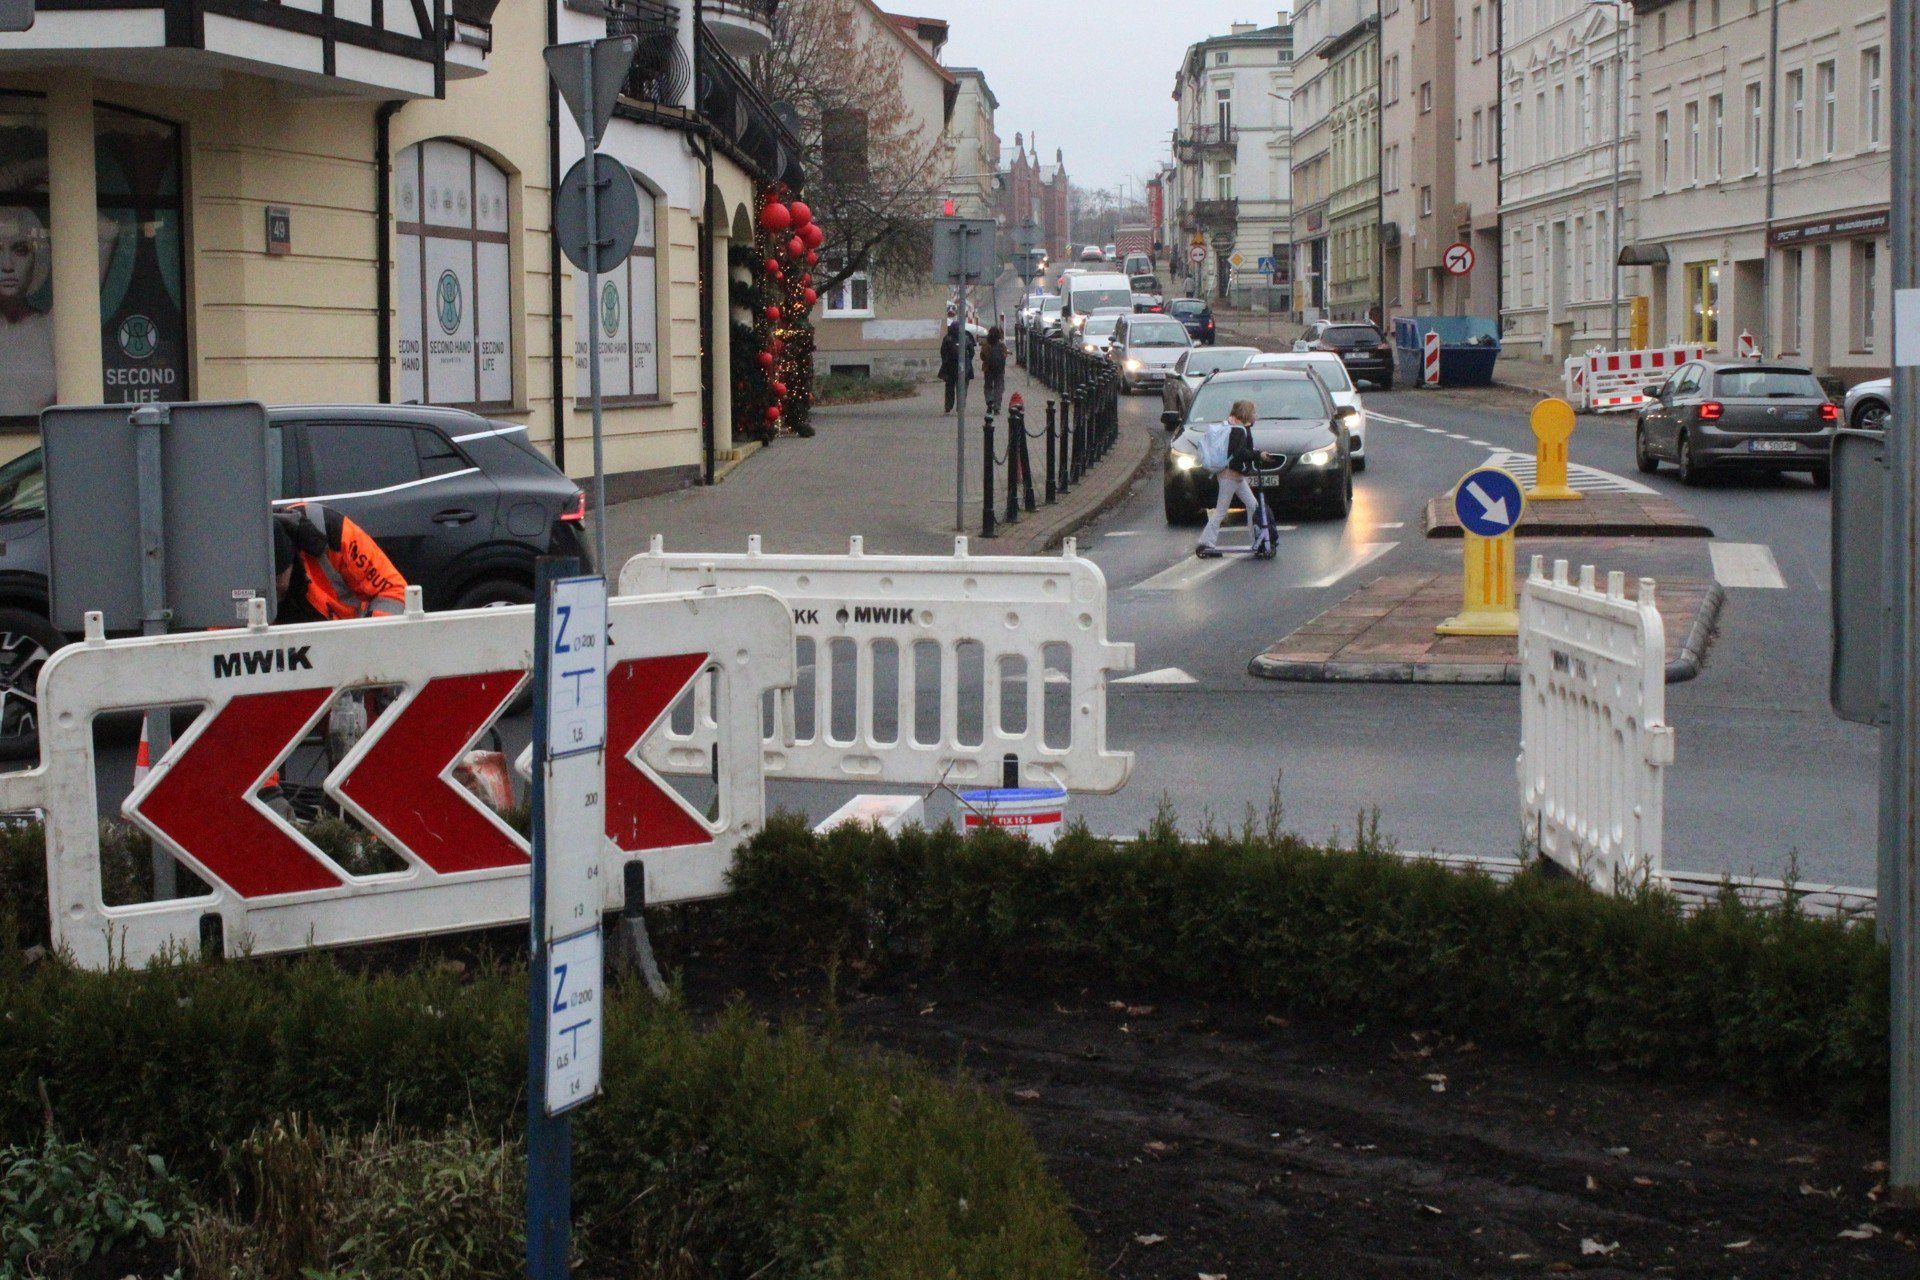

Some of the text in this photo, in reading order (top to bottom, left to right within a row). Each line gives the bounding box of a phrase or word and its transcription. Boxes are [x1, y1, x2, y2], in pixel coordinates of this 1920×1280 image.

[274, 220, 285, 238] 49
[430, 341, 472, 354] SECOND HAND
[481, 341, 505, 355] SECOND
[402, 357, 420, 371] HAND
[482, 358, 496, 371] LIFE
[106, 367, 175, 385] SECOND
[854, 606, 915, 625] MWIK
[554, 605, 572, 655] Z
[213, 645, 314, 679] MWIK
[584, 792, 599, 807] 200
[999, 817, 1013, 825] FIX
[553, 963, 568, 1014] Z
